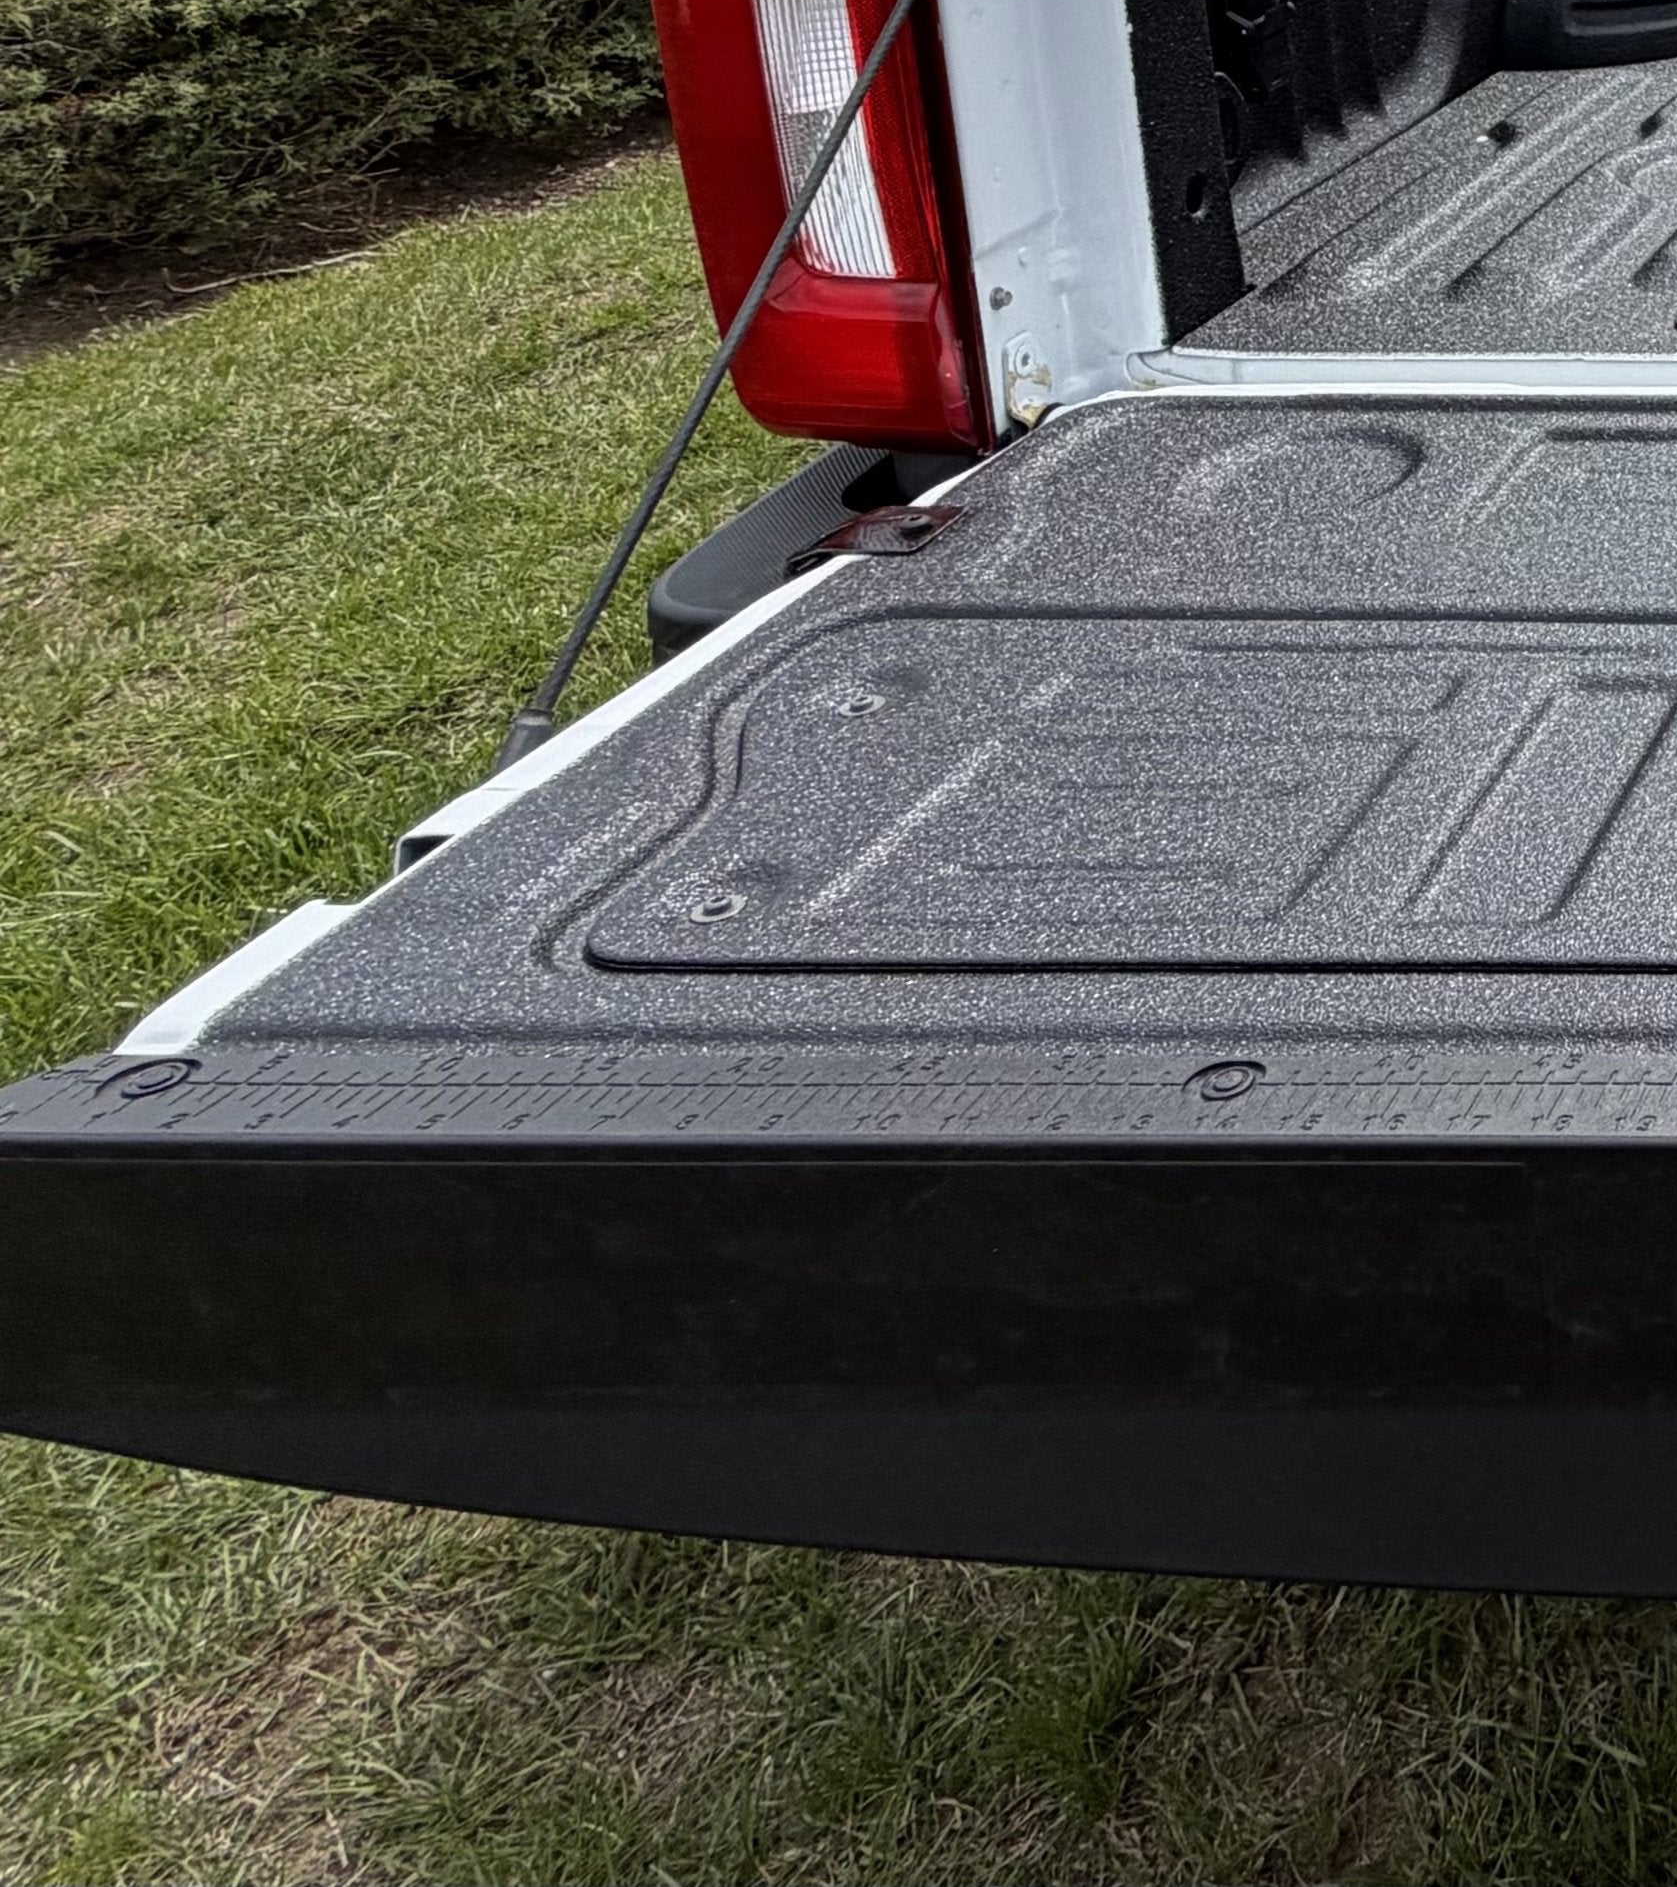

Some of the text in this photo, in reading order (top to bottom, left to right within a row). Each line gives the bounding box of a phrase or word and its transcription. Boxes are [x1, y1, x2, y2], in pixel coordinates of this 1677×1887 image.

[80, 1112, 107, 1130] 1
[156, 1113, 191, 1129] 2
[243, 1113, 274, 1130] 3
[331, 1114, 360, 1129] 4
[414, 1113, 447, 1130] 5
[497, 1113, 531, 1130] 6
[588, 1114, 618, 1131] 7
[674, 1114, 700, 1131] 8
[759, 1114, 784, 1131] 9
[852, 1114, 901, 1131] 10
[1279, 1114, 1323, 1131] 15
[1362, 1113, 1407, 1131] 16
[1447, 1114, 1492, 1131] 17
[1531, 1114, 1574, 1131] 18
